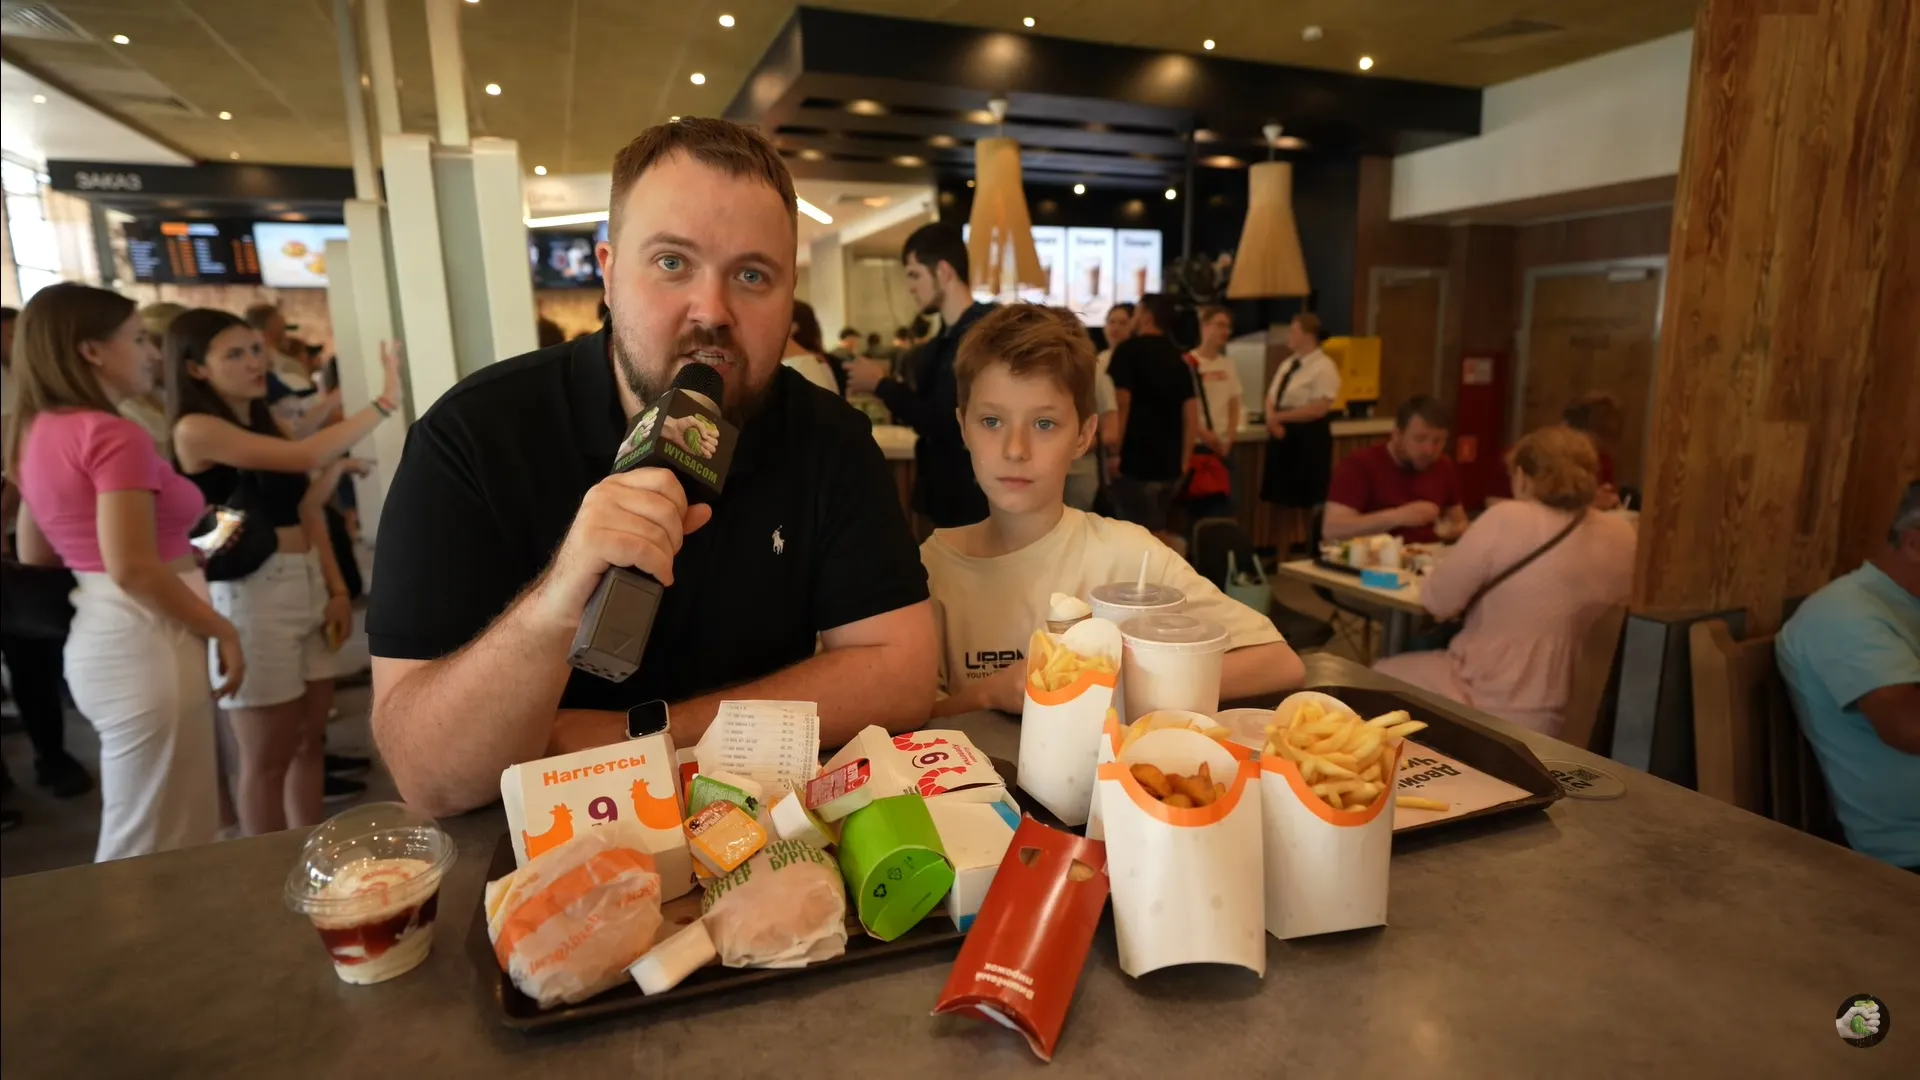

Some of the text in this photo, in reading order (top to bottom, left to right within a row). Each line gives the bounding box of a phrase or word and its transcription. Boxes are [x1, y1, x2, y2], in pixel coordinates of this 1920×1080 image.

[74, 171, 143, 191] ЗАКАЗ
[663, 442, 718, 484] WYLSACOM
[543, 754, 647, 787] Наггетсы
[920, 752, 949, 765] 6
[588, 796, 618, 823] 9
[984, 962, 1033, 985] пирожок
